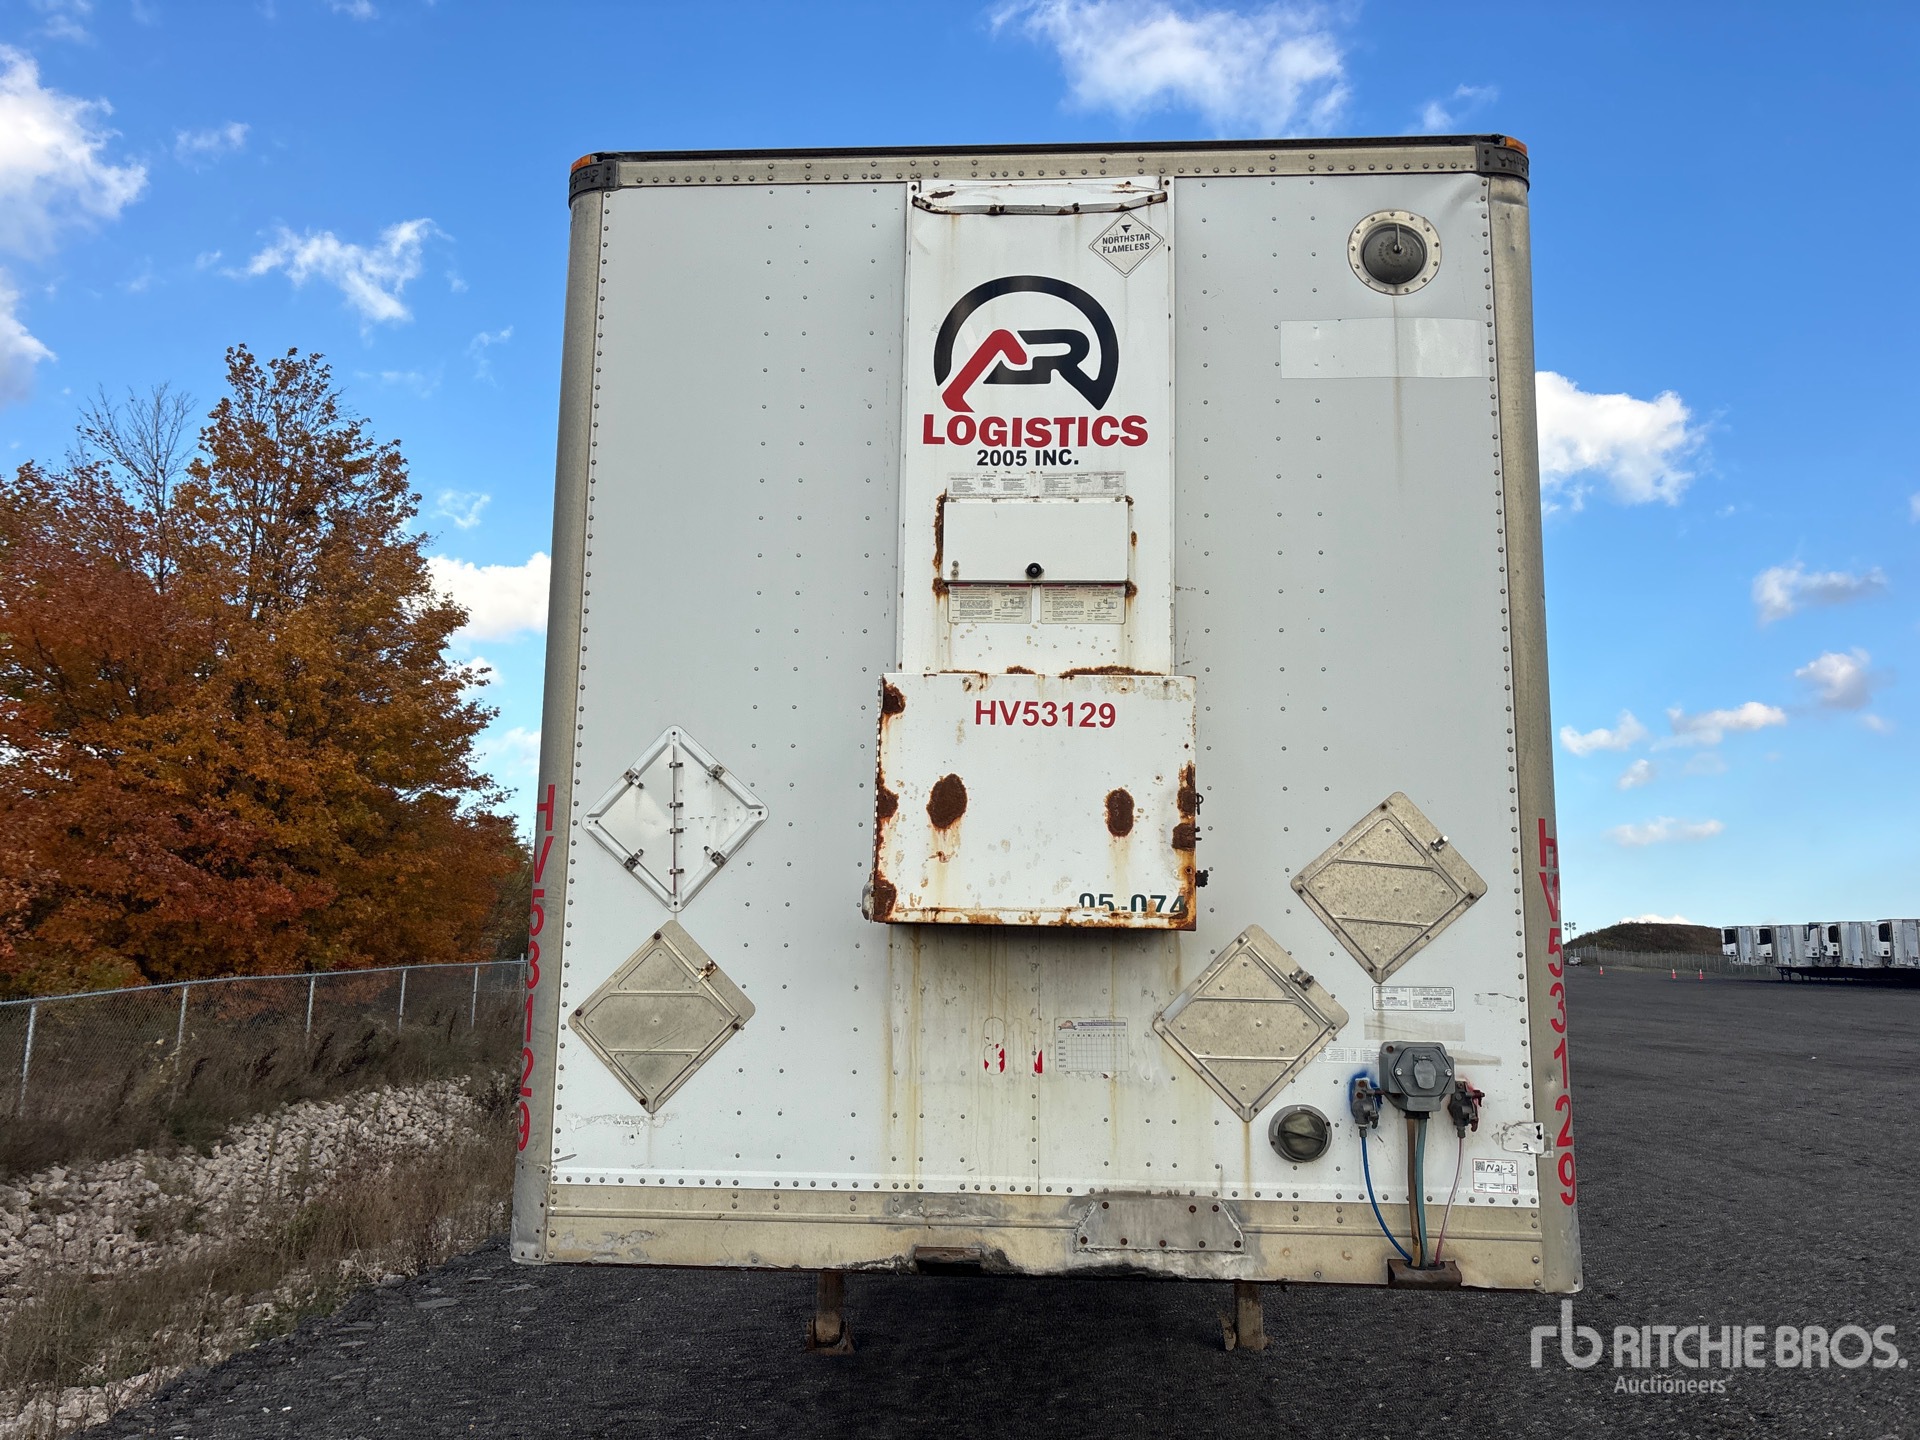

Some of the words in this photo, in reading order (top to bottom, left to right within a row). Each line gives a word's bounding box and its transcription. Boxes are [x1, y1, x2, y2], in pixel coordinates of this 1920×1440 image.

[1102, 232, 1151, 245] NORTHSTAR
[1102, 242, 1150, 254] FLAMELESS
[922, 413, 1149, 448] LOGISTICS
[976, 449, 1028, 466] 2005
[1035, 448, 1080, 466] INC.
[975, 700, 1116, 729] HV53129
[1537, 817, 1577, 1206] HV53129
